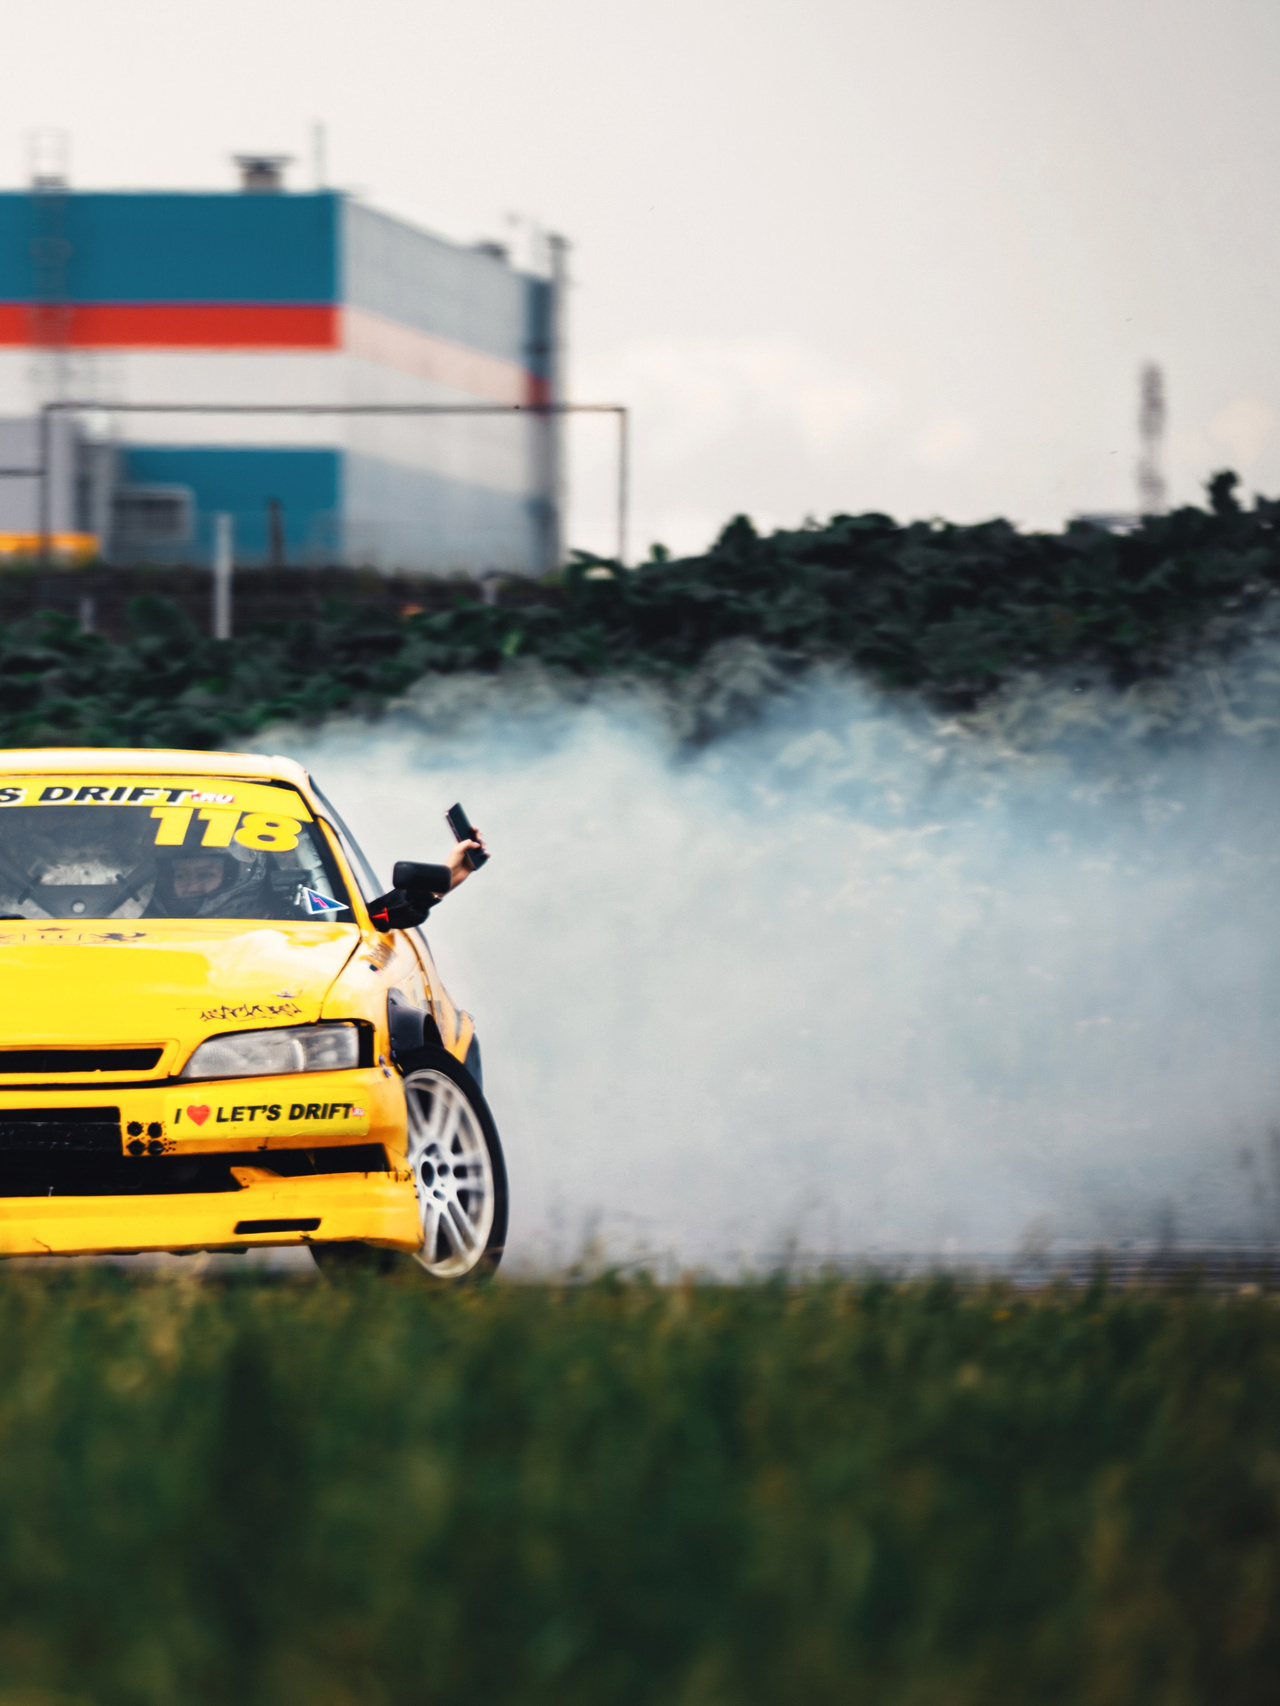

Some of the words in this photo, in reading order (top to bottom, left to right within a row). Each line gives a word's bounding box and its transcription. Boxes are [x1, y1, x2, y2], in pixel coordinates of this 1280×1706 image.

[150, 807, 302, 852] 118
[174, 1108, 182, 1124] I
[216, 1104, 282, 1123] LET'S
